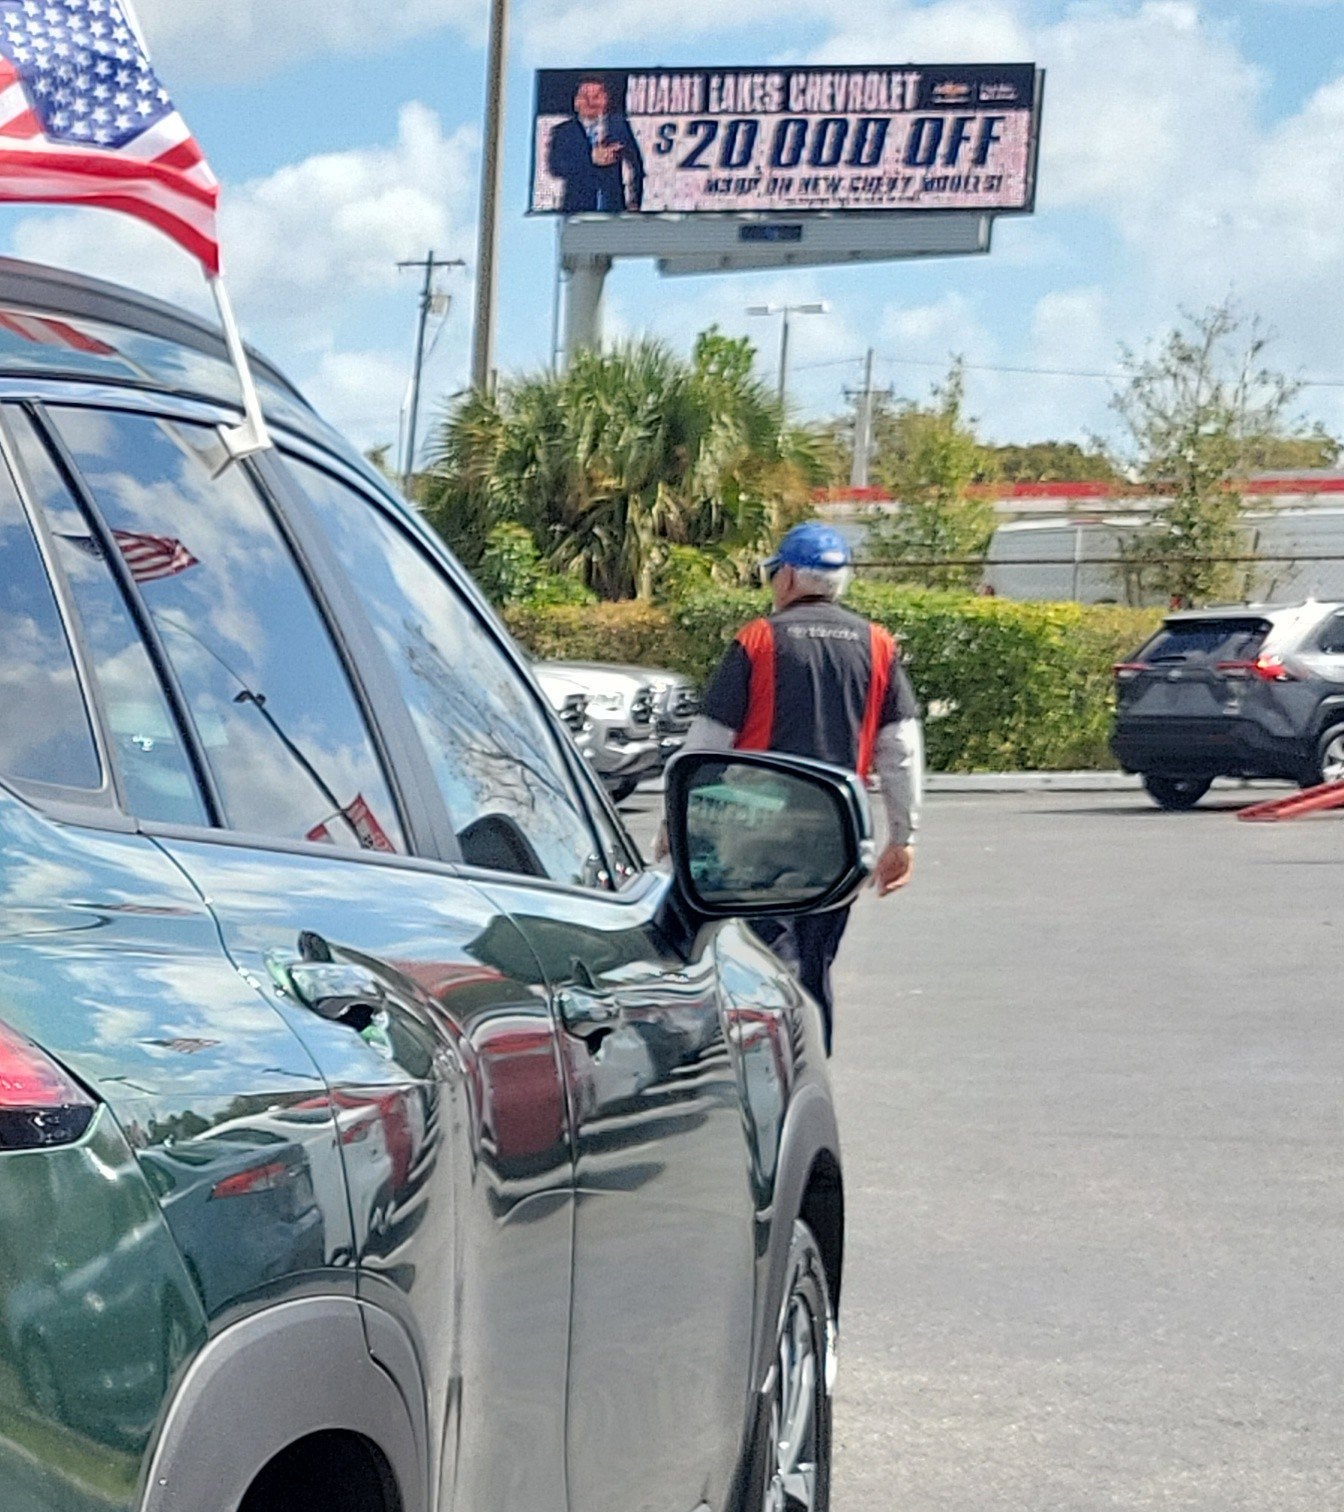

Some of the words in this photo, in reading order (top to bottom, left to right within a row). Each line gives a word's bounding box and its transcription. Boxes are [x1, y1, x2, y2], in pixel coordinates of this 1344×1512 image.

[626, 73, 706, 113] MIAMI
[709, 73, 786, 112] LAKES
[789, 71, 921, 112] CHEVROLET
[903, 116, 1006, 167] OFF
